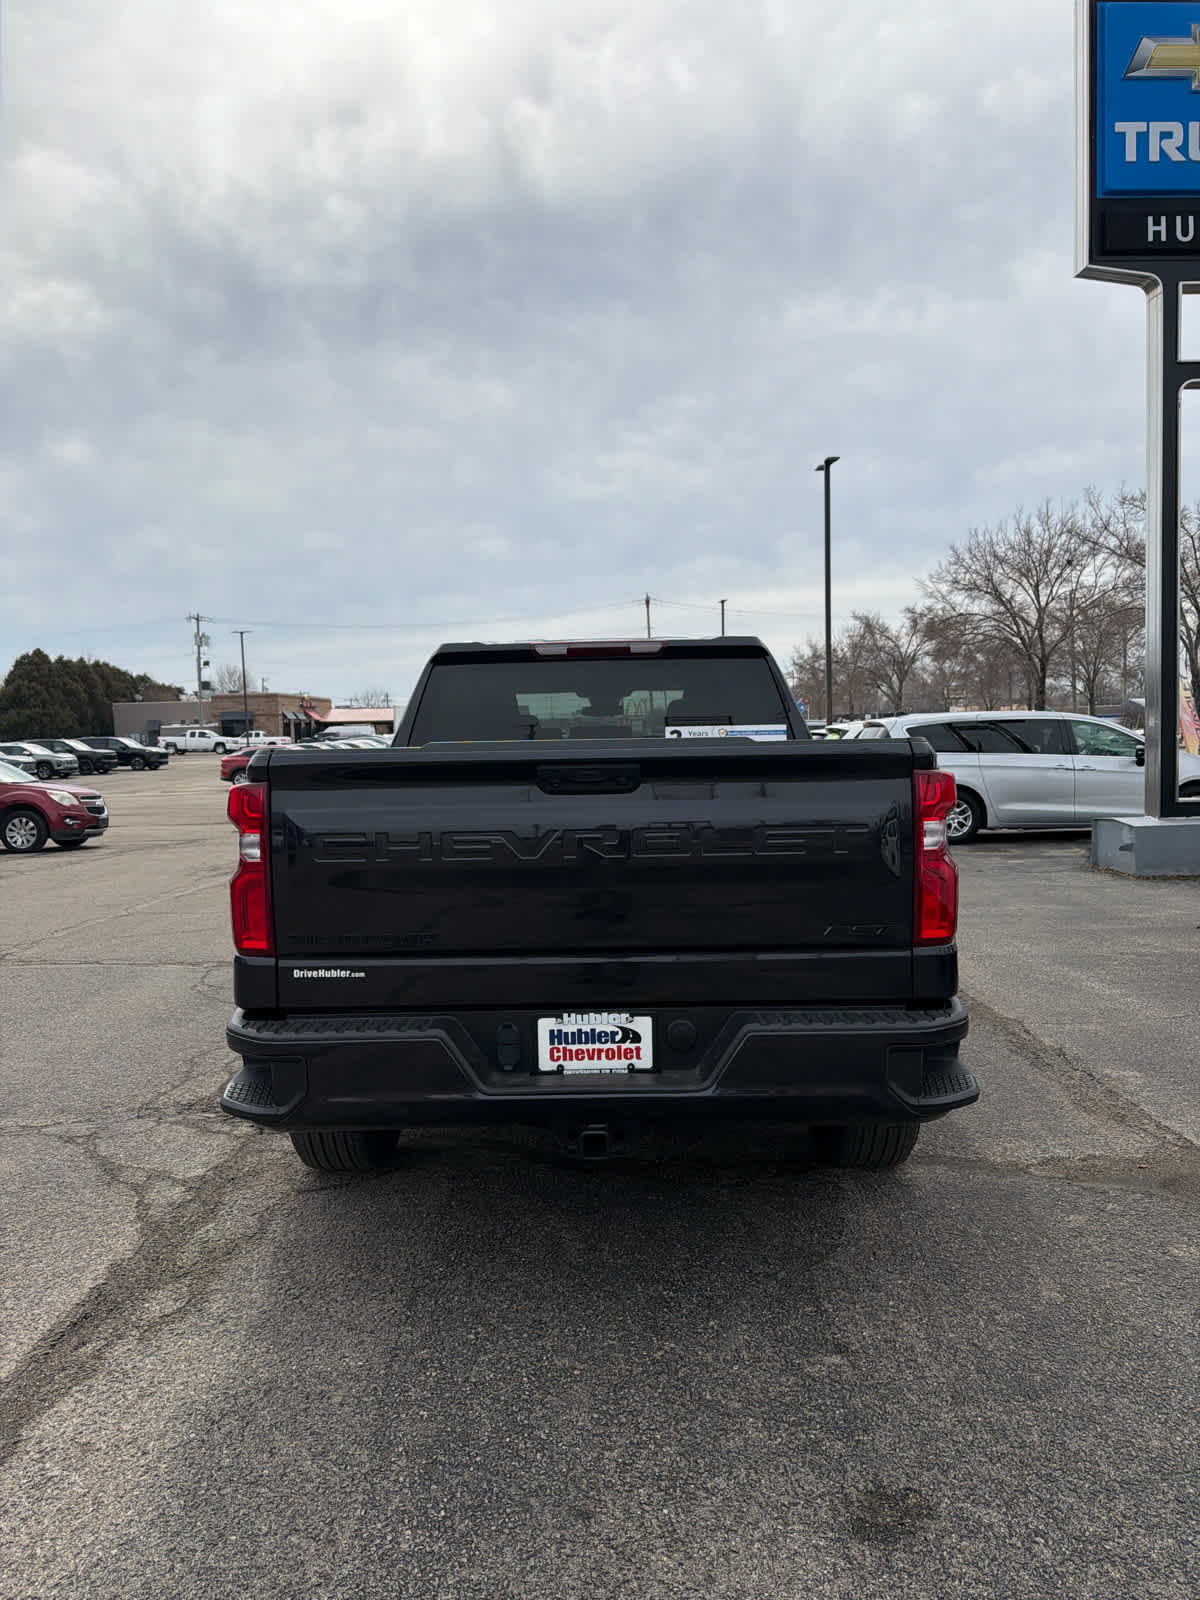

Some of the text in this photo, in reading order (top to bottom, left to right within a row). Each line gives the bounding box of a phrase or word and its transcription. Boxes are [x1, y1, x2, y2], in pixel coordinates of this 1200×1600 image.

[1147, 215, 1195, 242] HU
[312, 821, 869, 862] CHEVROLET
[549, 1028, 619, 1046] Hubler
[549, 1045, 642, 1062] Chevrolet
